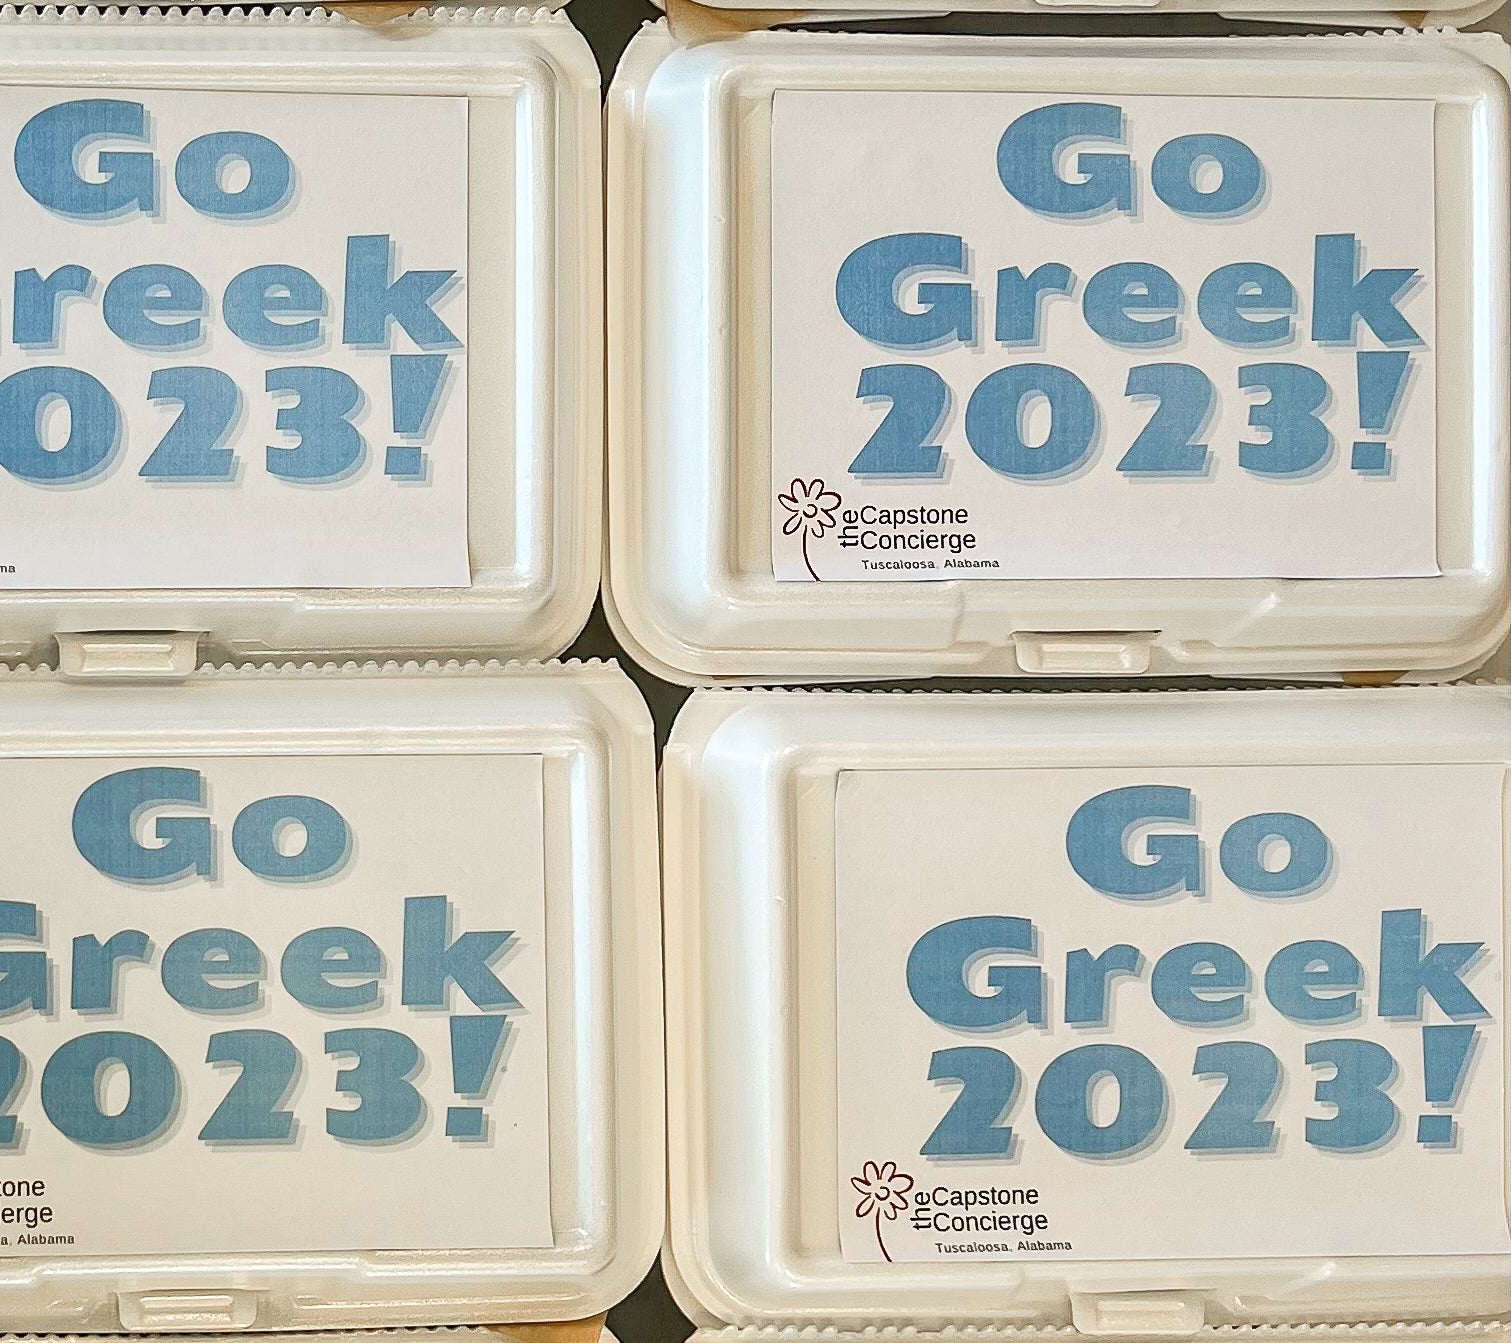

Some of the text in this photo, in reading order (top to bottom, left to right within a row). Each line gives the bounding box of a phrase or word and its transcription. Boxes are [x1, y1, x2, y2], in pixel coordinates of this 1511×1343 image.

[14, 99, 296, 220] Go
[997, 102, 1266, 220] Go
[836, 232, 1426, 351] Greek
[848, 351, 1414, 481] 2023!
[836, 509, 860, 549] the
[859, 504, 969, 530] Capstone
[860, 528, 977, 554] Concierge
[943, 558, 1001, 569] Alabama
[72, 767, 353, 886] Go
[1066, 785, 1333, 901] Go
[906, 908, 1492, 1033] Greek
[919, 1024, 1481, 1161] 2023!
[909, 1191, 933, 1232] the
[931, 1186, 1039, 1212] Capstone
[16, 1233, 75, 1246] Alabama
[932, 1209, 1049, 1236] Concierge
[1016, 1240, 1073, 1251] Alabama
